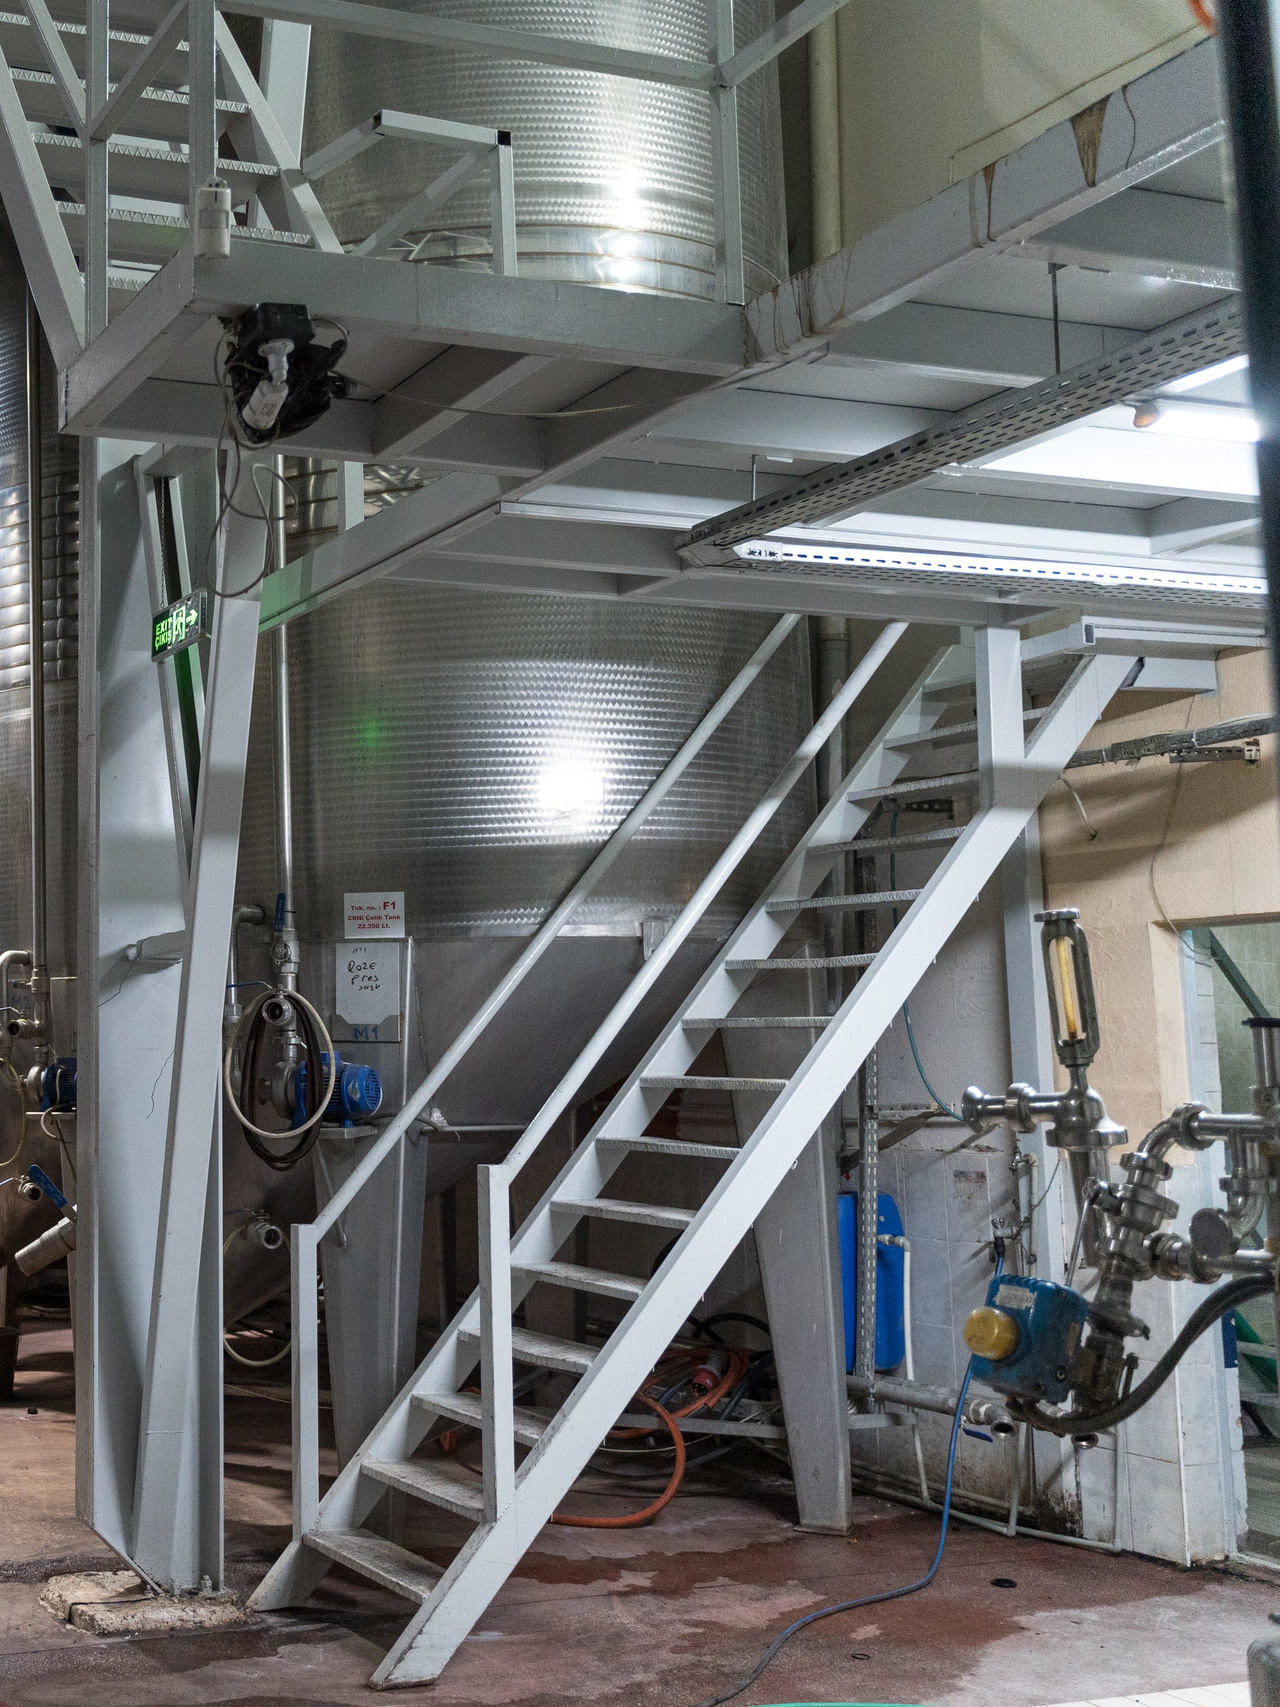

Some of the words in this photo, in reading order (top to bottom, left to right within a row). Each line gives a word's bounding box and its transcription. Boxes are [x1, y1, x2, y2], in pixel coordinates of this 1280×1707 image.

[156, 617, 172, 636] EXIT
[155, 630, 172, 650] ÇIKIŞ
[383, 901, 396, 910] F1
[353, 1025, 379, 1040] M1
